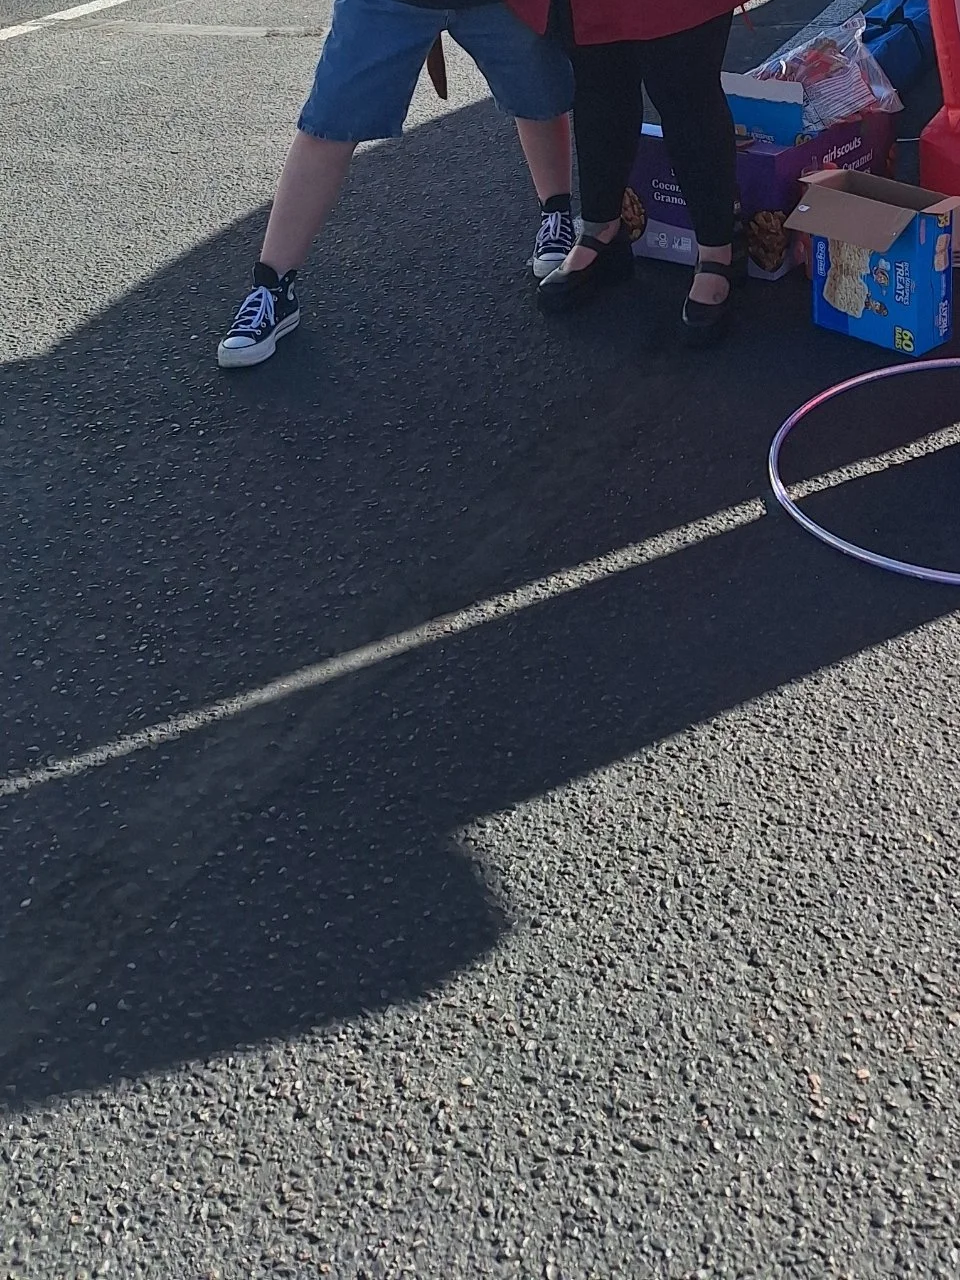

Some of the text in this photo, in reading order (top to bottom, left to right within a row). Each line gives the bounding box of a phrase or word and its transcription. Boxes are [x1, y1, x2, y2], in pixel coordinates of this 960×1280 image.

[837, 135, 862, 159] scouts
[895, 261, 905, 303] TREATS
[894, 326, 902, 350] BARS
[901, 329, 914, 353] 60
